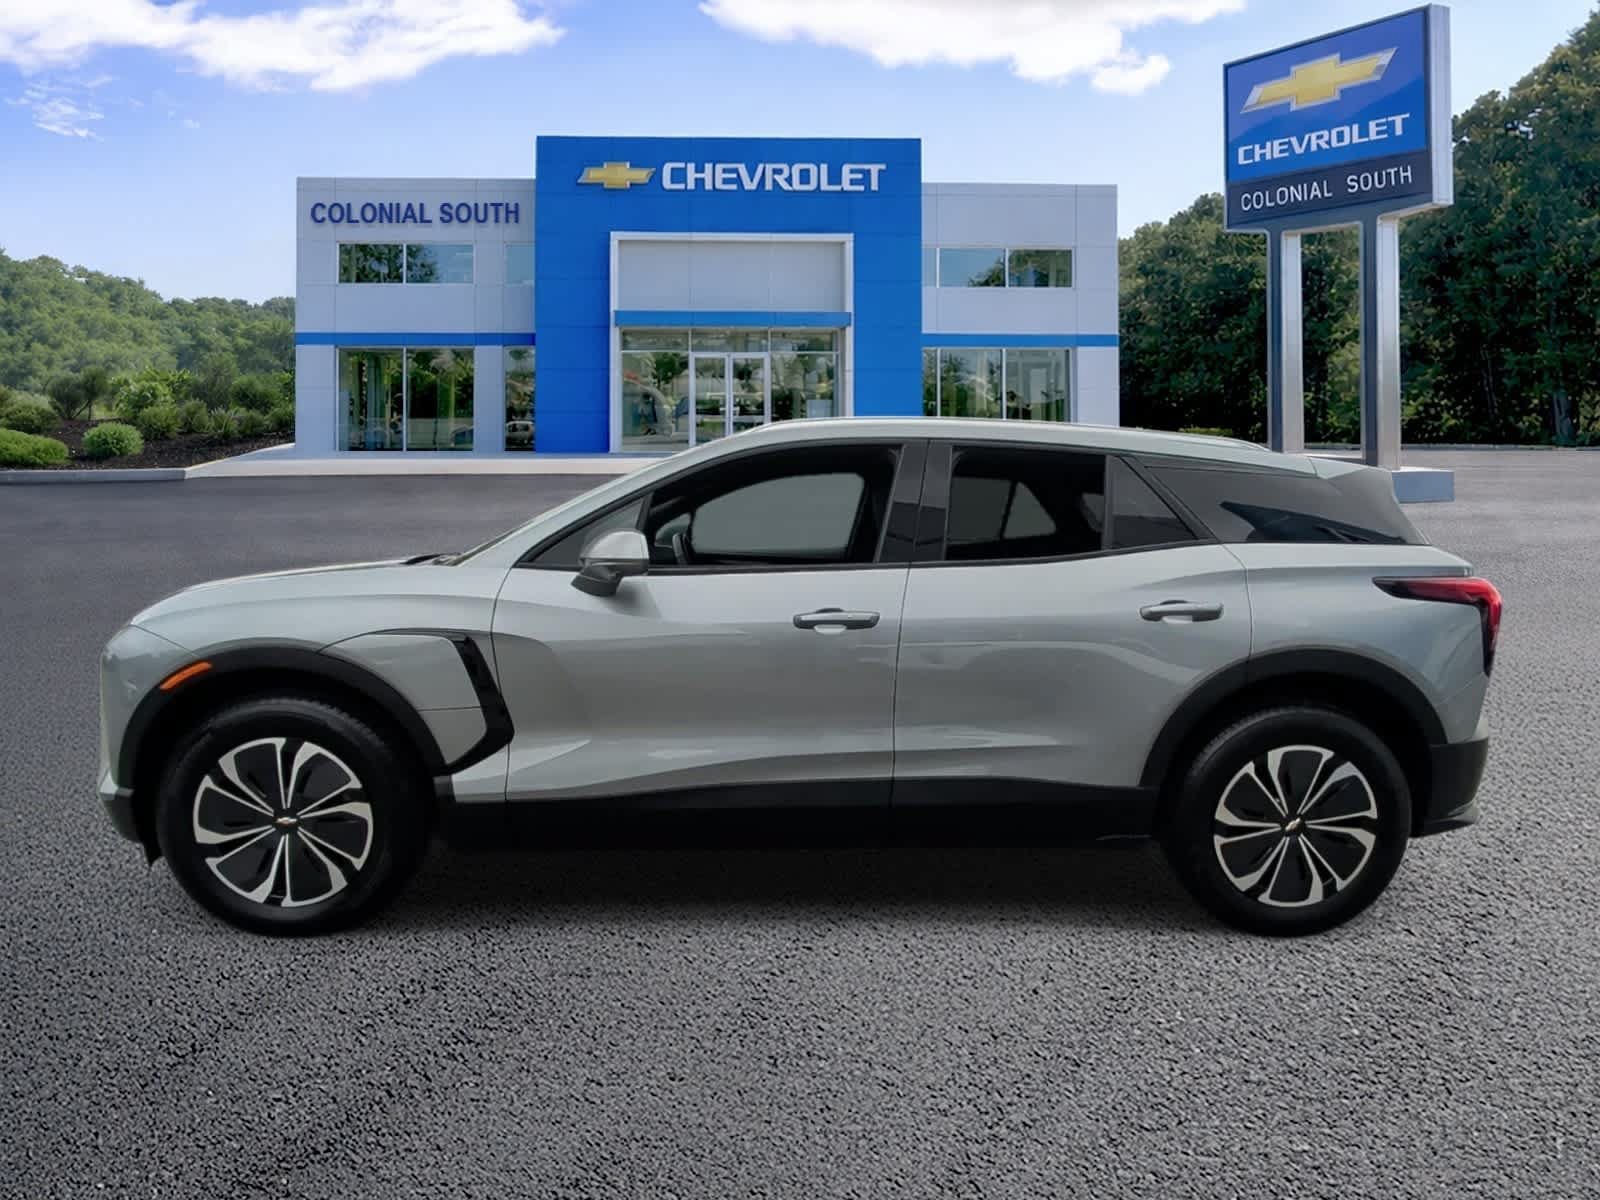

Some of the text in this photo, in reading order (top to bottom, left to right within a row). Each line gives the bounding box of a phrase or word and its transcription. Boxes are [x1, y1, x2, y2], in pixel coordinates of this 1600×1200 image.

[1237, 112, 1410, 165] CHEVROLET
[662, 161, 887, 192] CHEVROLET
[1240, 164, 1413, 212] COLONIAL SOUTH
[310, 202, 520, 225] COLONIAL SOUTH
